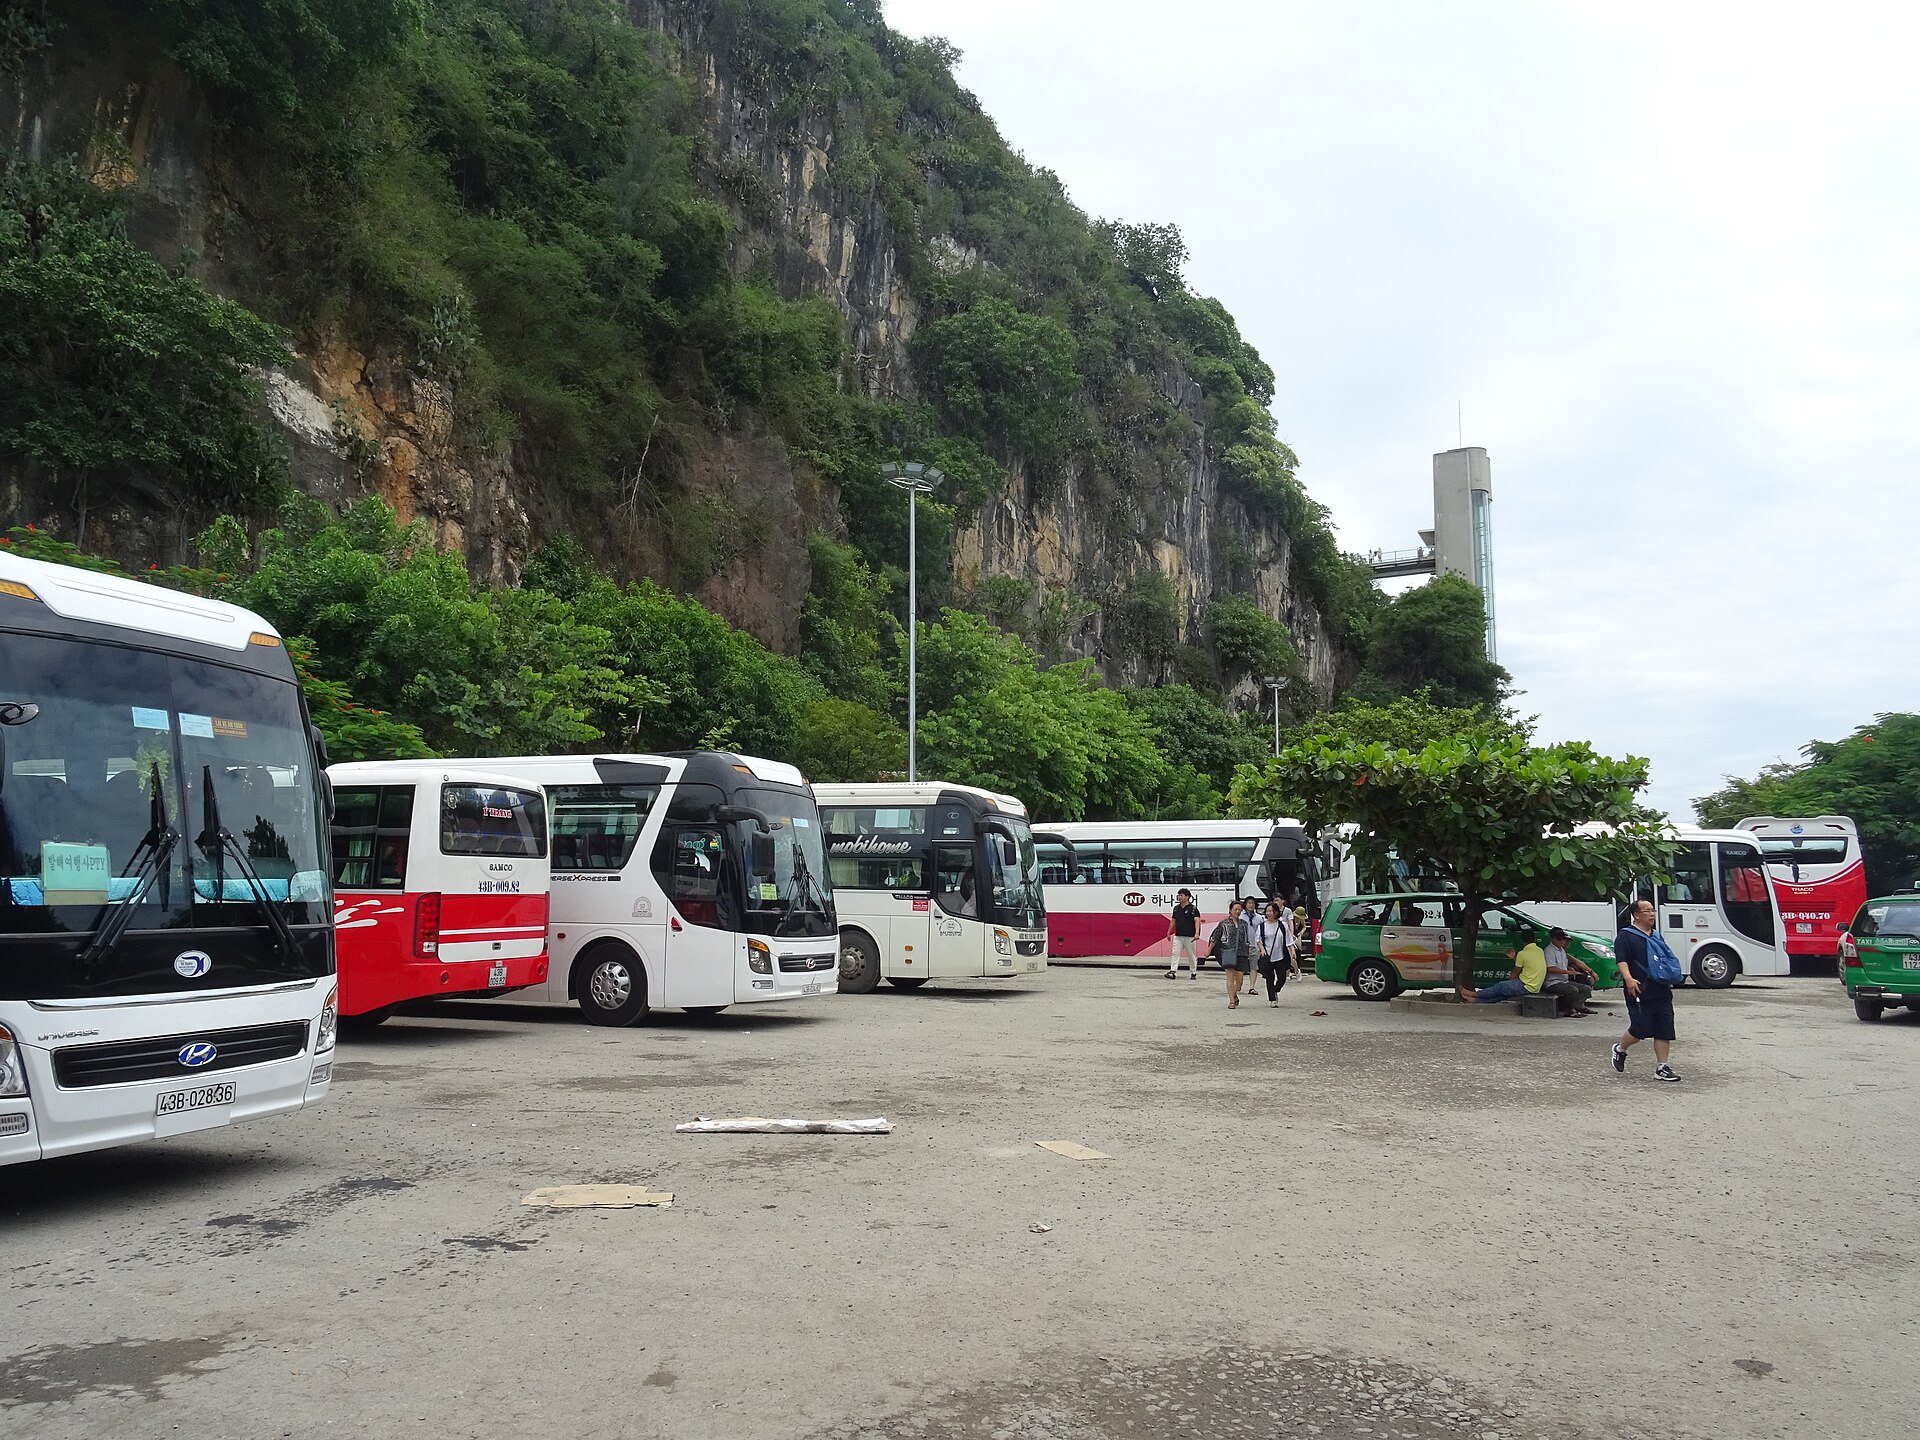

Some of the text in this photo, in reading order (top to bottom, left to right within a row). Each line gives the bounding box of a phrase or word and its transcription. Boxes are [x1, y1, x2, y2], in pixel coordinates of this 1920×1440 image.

[829, 834, 912, 854] mobihome
[489, 863, 514, 872] SAMCO
[478, 880, 520, 893] 43B-009.82
[1124, 895, 1144, 905] HNT
[1151, 894, 1198, 907] 하나어
[1780, 912, 1831, 921] 3B-040.70
[159, 1085, 233, 1112] 43B-028.36
